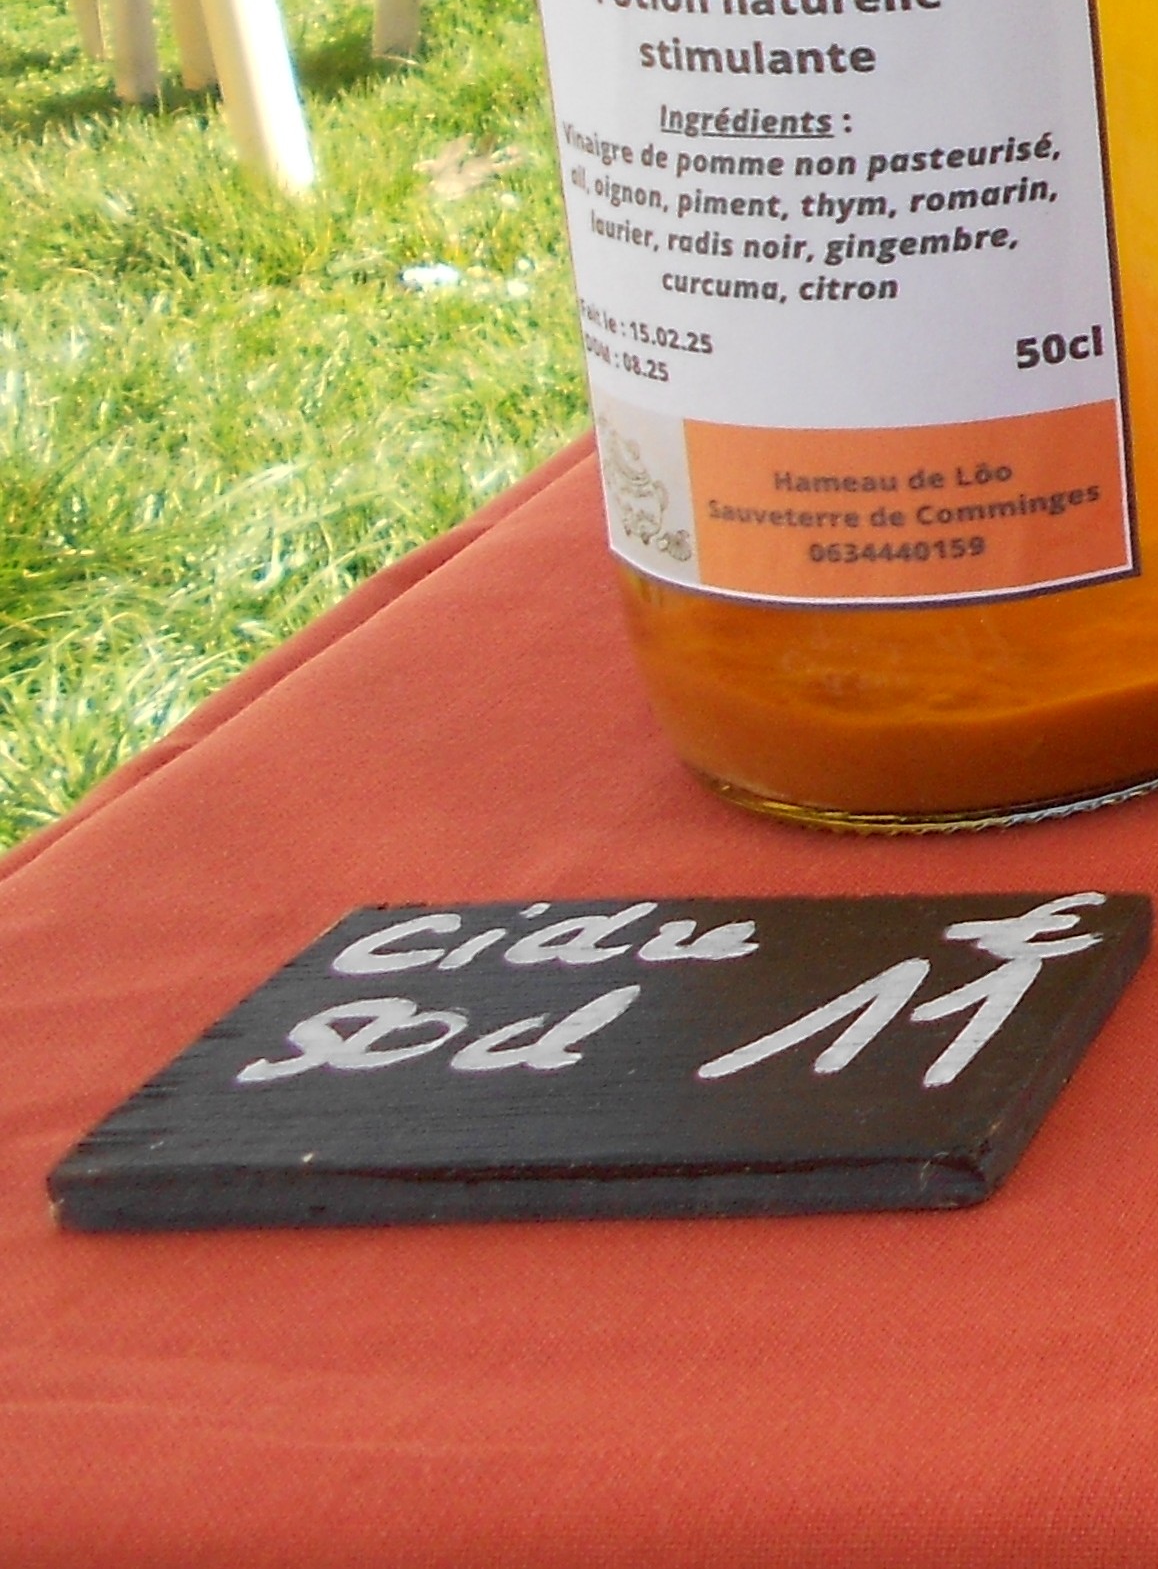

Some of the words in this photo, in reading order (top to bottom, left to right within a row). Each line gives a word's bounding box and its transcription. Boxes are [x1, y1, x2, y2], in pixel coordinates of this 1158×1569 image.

[640, 38, 876, 75] stimulante
[563, 120, 633, 166] Vinaigre
[641, 143, 667, 169] de
[676, 151, 784, 178] pomme
[795, 151, 856, 176] non
[867, 132, 1061, 180] pasteurisé,
[595, 175, 668, 213] oignon,
[678, 189, 789, 221] piment,
[801, 192, 896, 224] thym,
[909, 178, 1059, 213] romarin,
[591, 209, 658, 252] laurier,
[668, 231, 734, 257] radis
[744, 236, 813, 263] noir,
[825, 225, 1018, 265] gingembre,
[661, 270, 788, 304] curcuma,
[799, 275, 899, 300] citron
[630, 321, 713, 354] 15.02.25
[1015, 326, 1104, 370] 50cl
[623, 351, 669, 381] 08.25
[774, 469, 897, 493] Hameau
[909, 468, 943, 490] de
[708, 500, 861, 530] Sauveterre
[870, 506, 905, 529] de
[916, 482, 1100, 525] Comminges
[810, 537, 986, 563] 0634440159
[697, 955, 1040, 1090] 11
